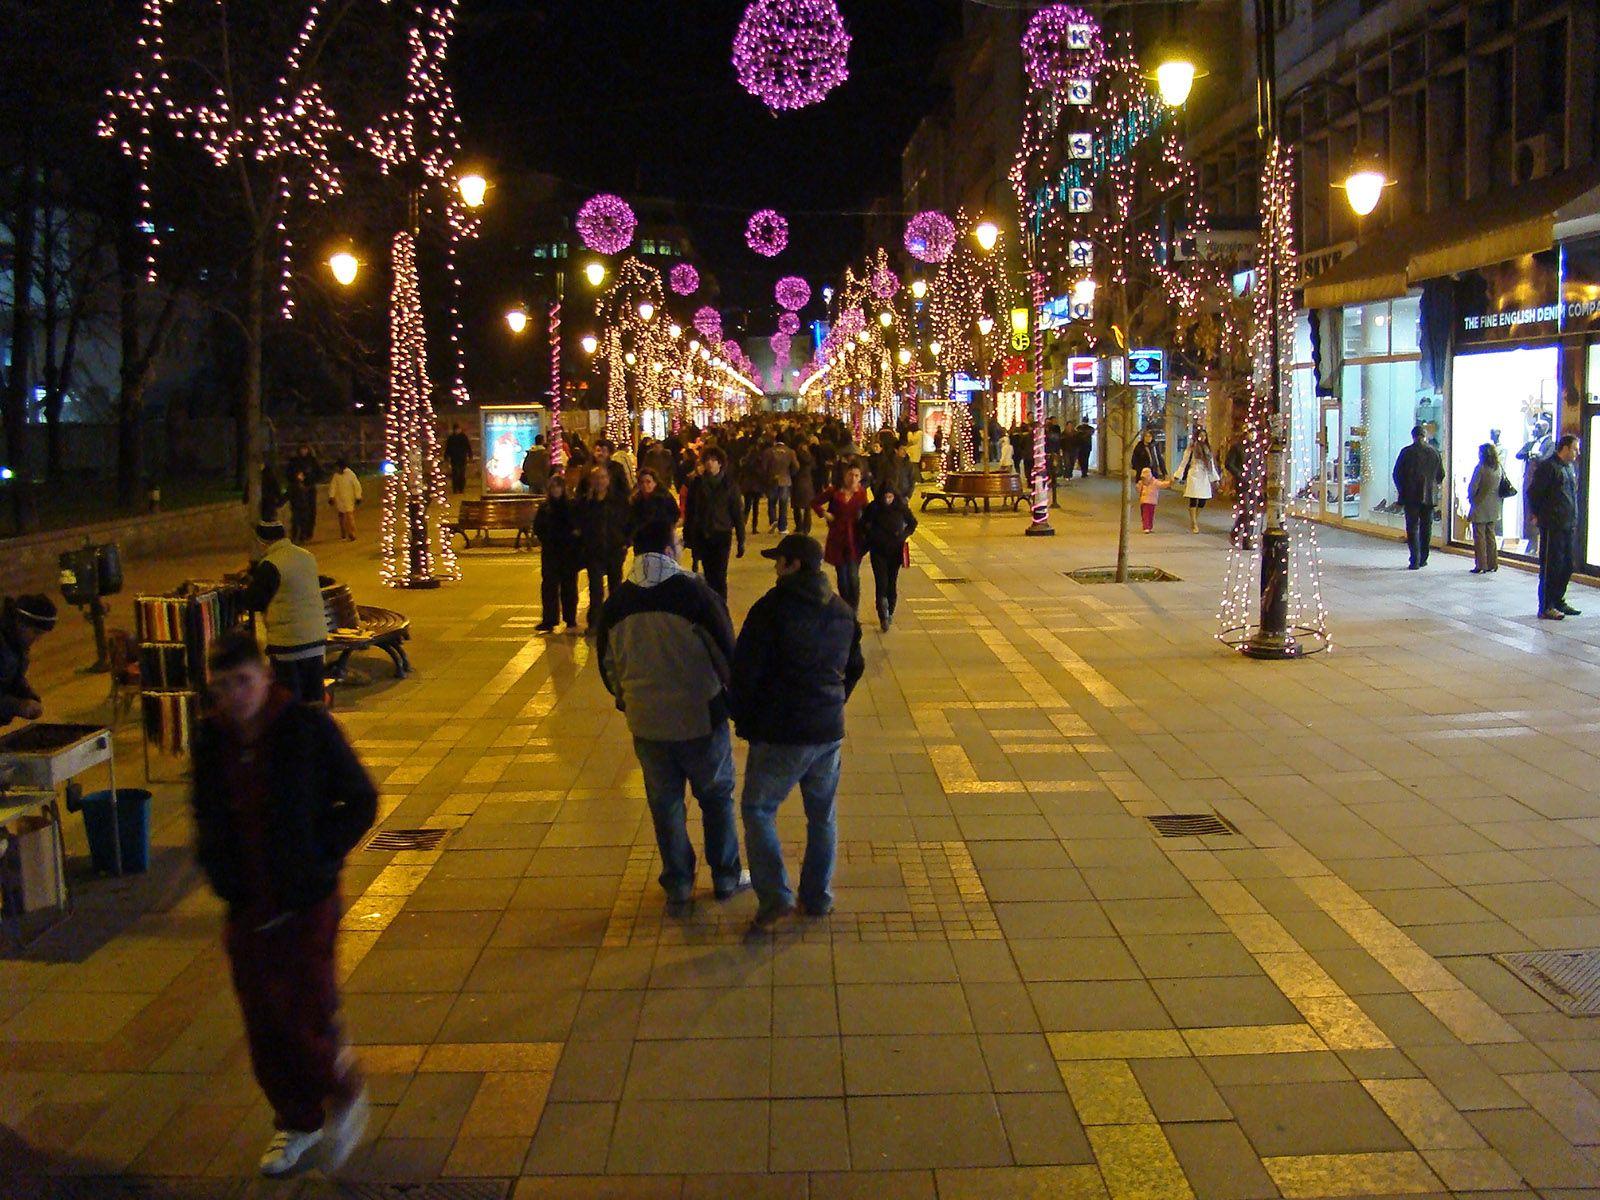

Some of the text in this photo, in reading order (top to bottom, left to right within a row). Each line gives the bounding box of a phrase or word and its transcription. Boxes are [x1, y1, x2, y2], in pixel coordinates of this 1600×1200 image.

[1464, 316, 1479, 330] THE
[1480, 314, 1498, 328] FINE
[1500, 308, 1536, 326] ENGLISH
[1537, 304, 1565, 322] DENIM
